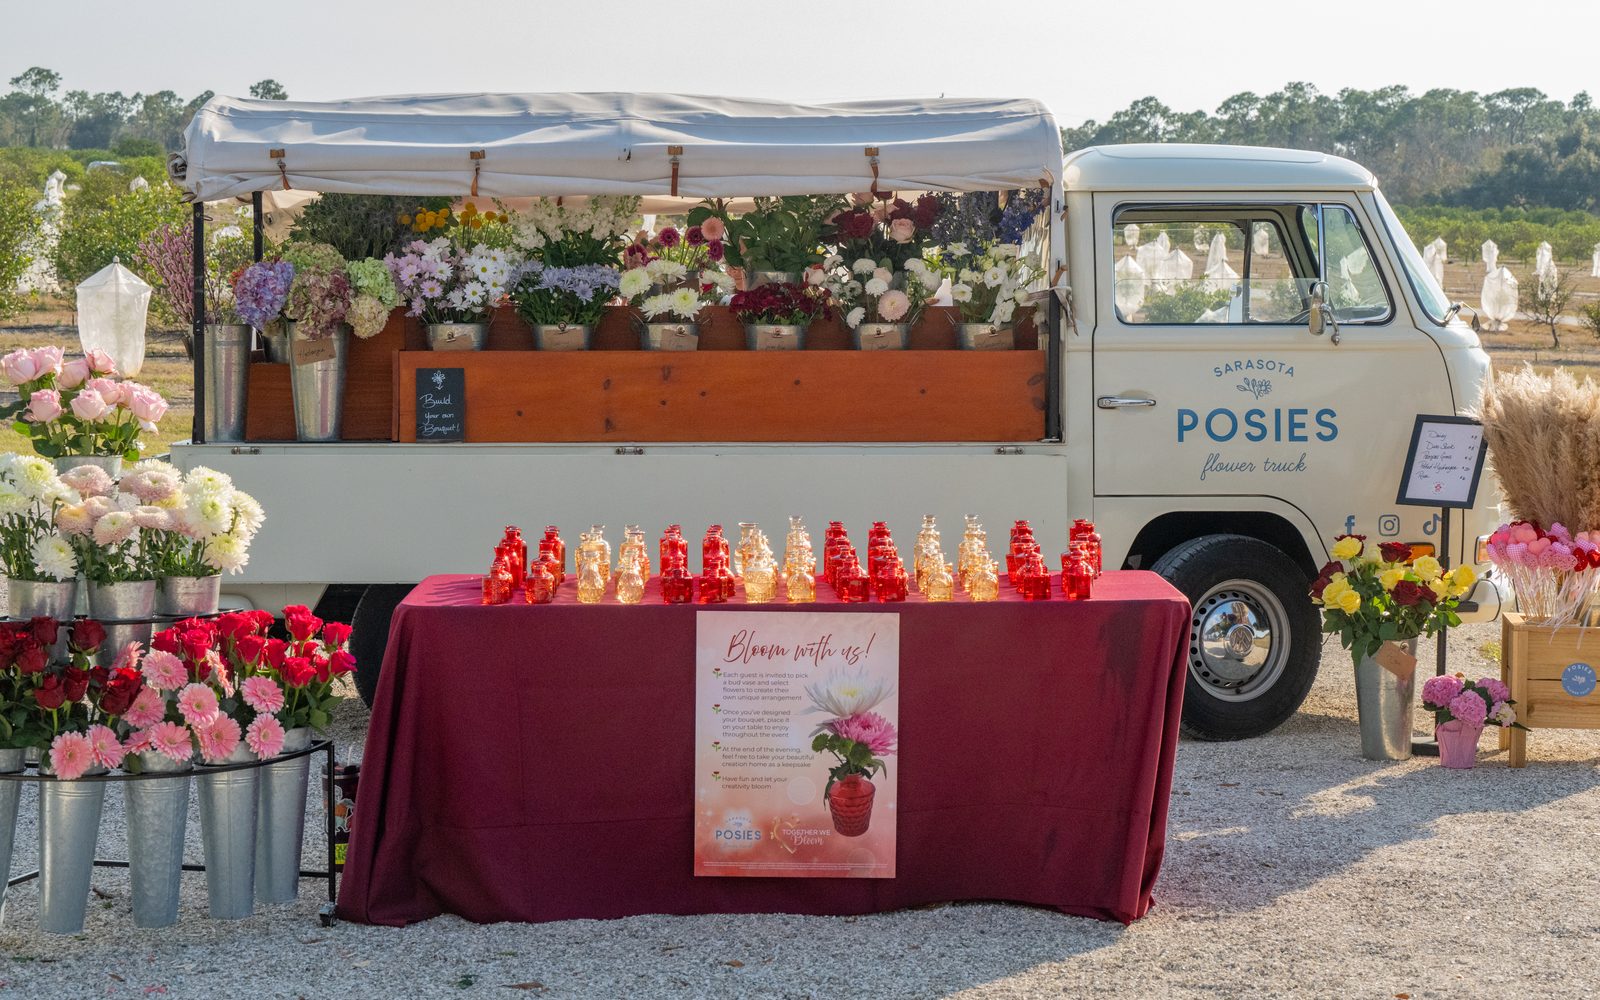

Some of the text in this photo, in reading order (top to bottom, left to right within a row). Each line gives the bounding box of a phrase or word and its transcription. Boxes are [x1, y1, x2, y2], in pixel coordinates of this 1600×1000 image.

[1213, 359, 1295, 377] SARASOTA
[420, 393, 453, 409] Build
[1177, 407, 1339, 443] POSIES
[1200, 452, 1308, 481] flower truck
[723, 629, 876, 667] Bloom with us!
[716, 830, 762, 840] POSIES
